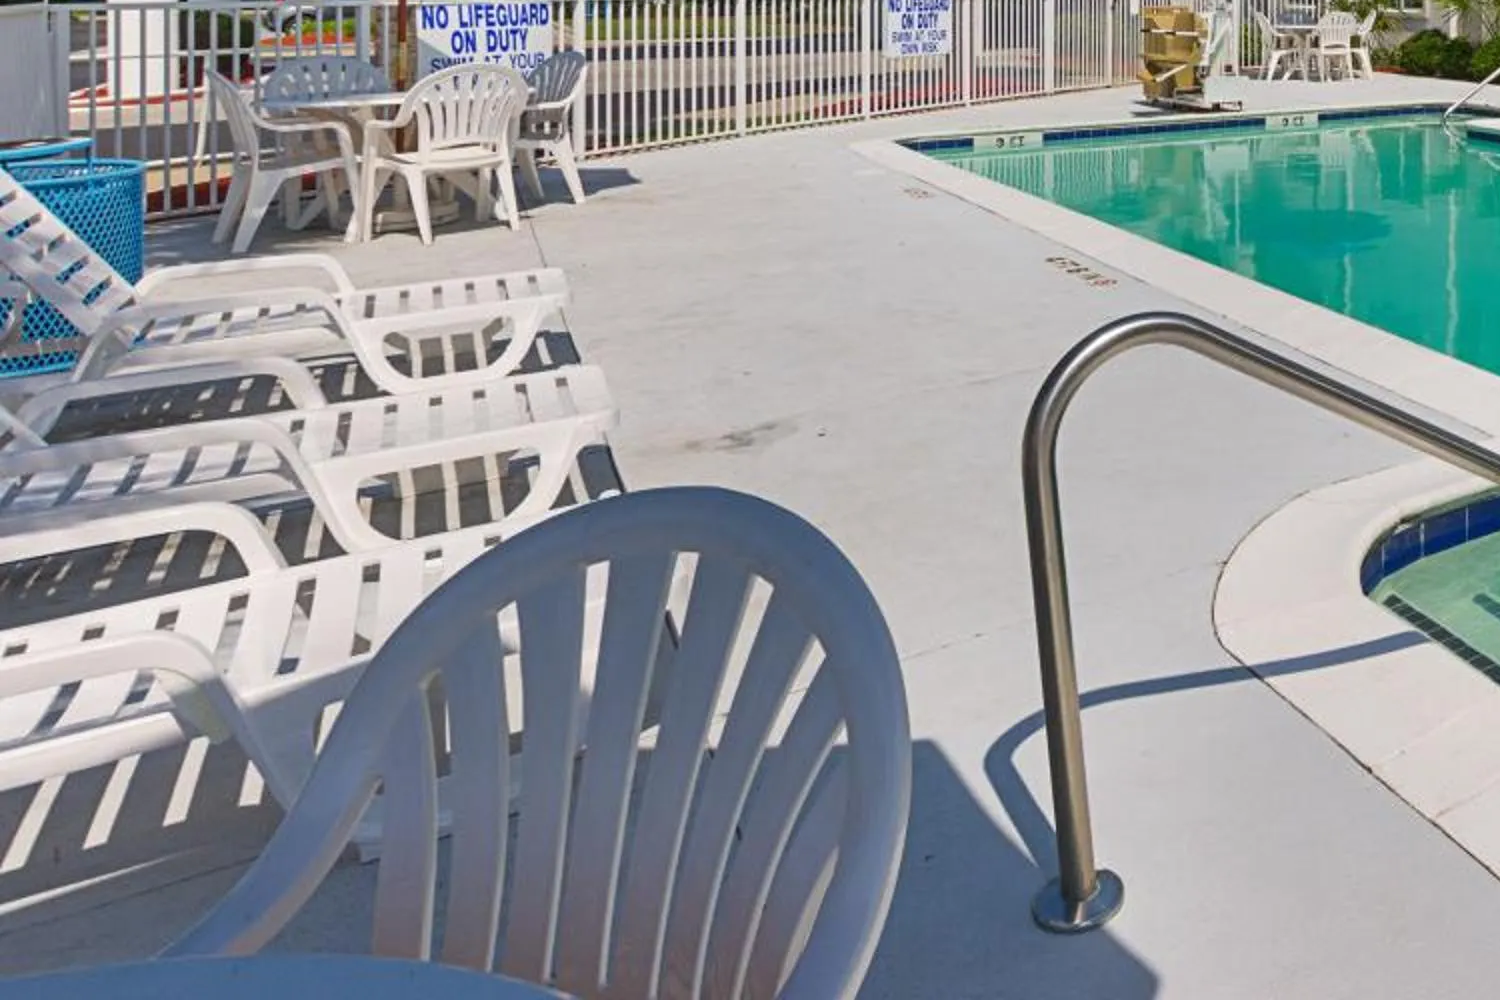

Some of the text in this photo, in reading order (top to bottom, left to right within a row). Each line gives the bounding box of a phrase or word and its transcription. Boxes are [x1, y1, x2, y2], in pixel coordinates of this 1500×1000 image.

[421, 3, 549, 29] NO LIFEGUARD
[901, 12, 939, 29] ON DUTY
[451, 28, 528, 53] ON DUTY
